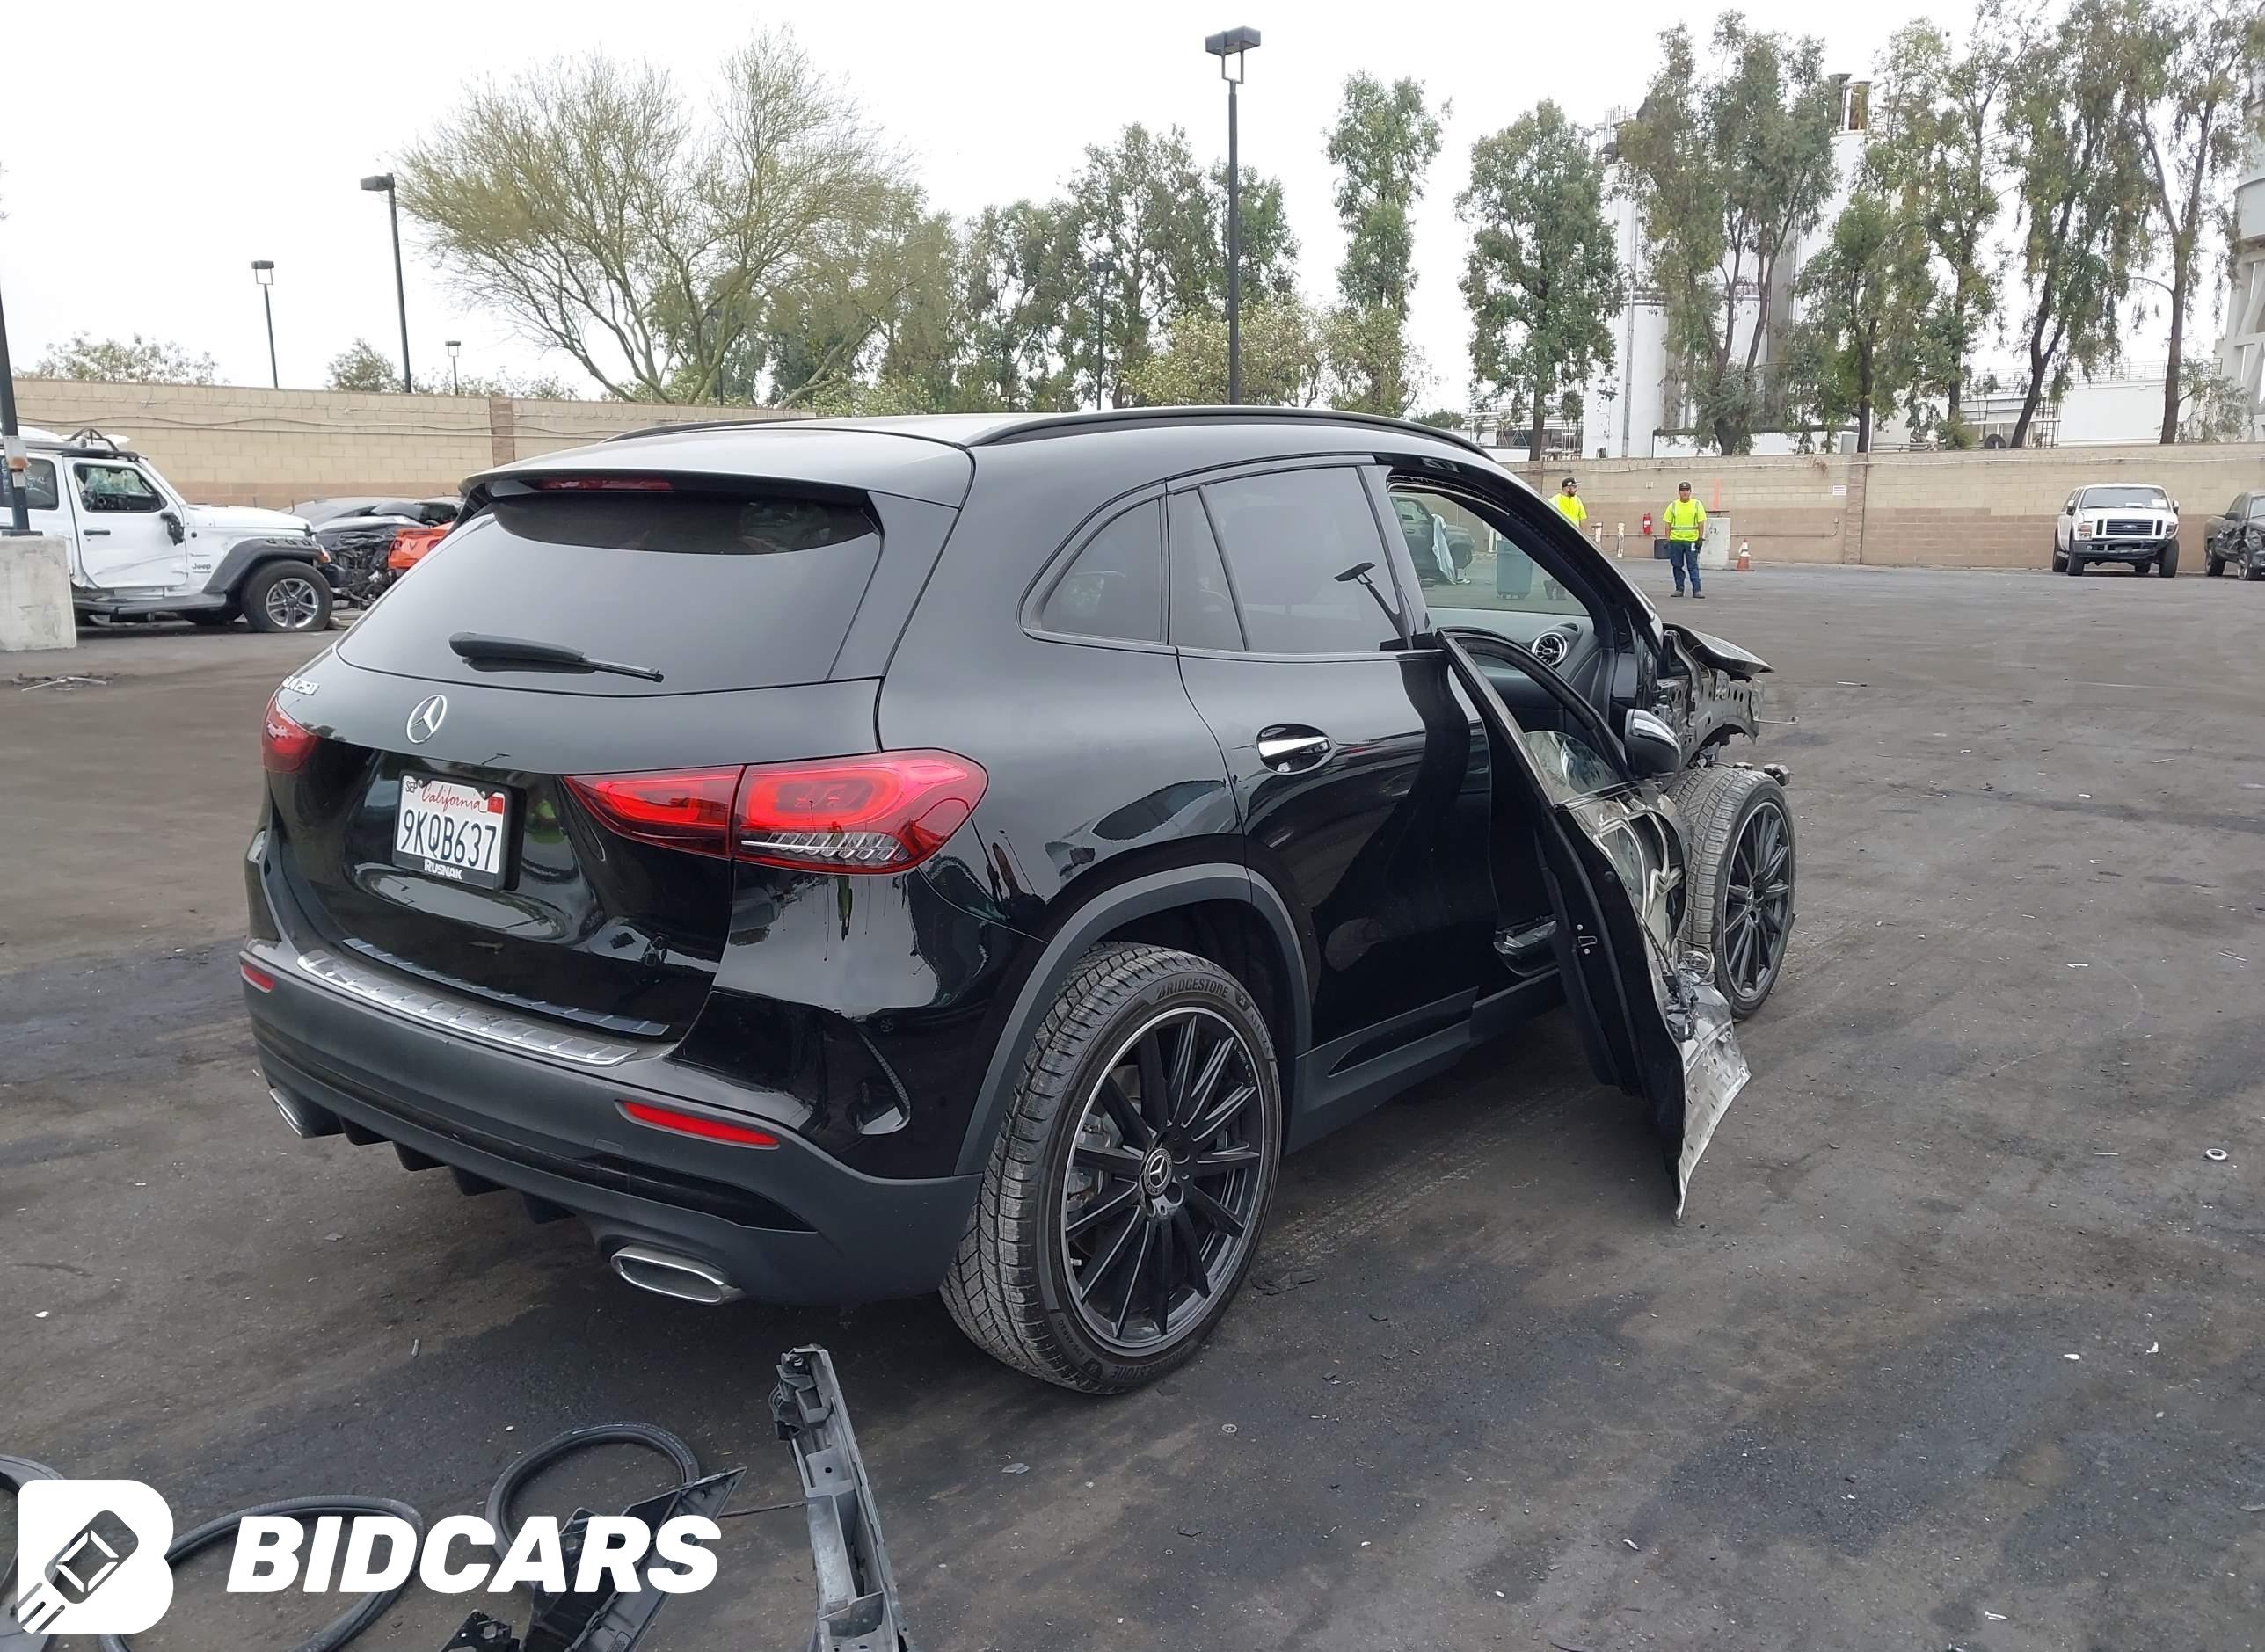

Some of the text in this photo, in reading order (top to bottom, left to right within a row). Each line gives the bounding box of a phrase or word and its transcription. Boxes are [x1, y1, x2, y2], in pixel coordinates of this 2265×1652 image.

[191, 562, 212, 571] Jeep
[421, 782, 487, 813] California
[400, 808, 498, 871] 9KQB637
[423, 858, 463, 880] RUSNAK
[1156, 977, 1229, 1001] BRIDGESTONE
